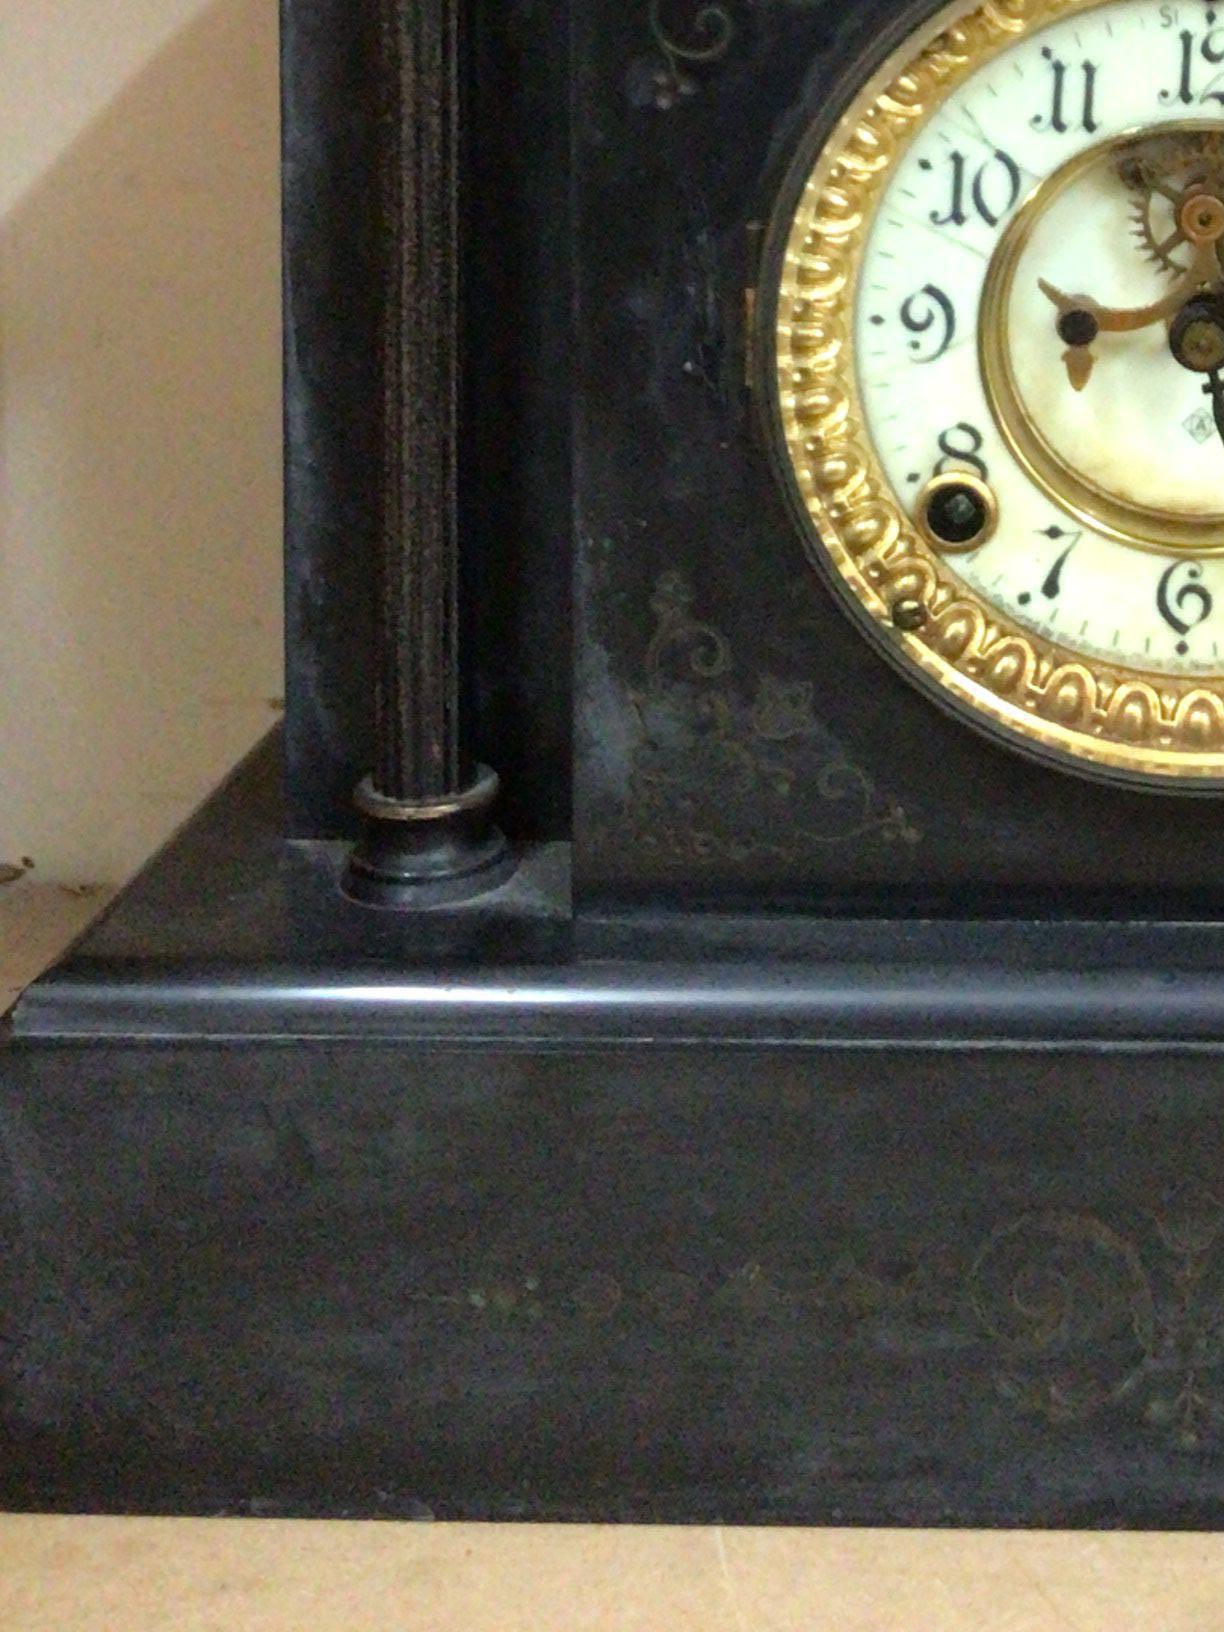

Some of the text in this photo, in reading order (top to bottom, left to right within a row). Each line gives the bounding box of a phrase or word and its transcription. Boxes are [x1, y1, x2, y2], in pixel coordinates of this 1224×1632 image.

[1031, 58, 1098, 134] 11
[930, 150, 1021, 228] 10
[900, 284, 956, 363] 9
[932, 422, 988, 484] 8
[1032, 524, 1083, 600] 7
[1156, 559, 1213, 636] 6
